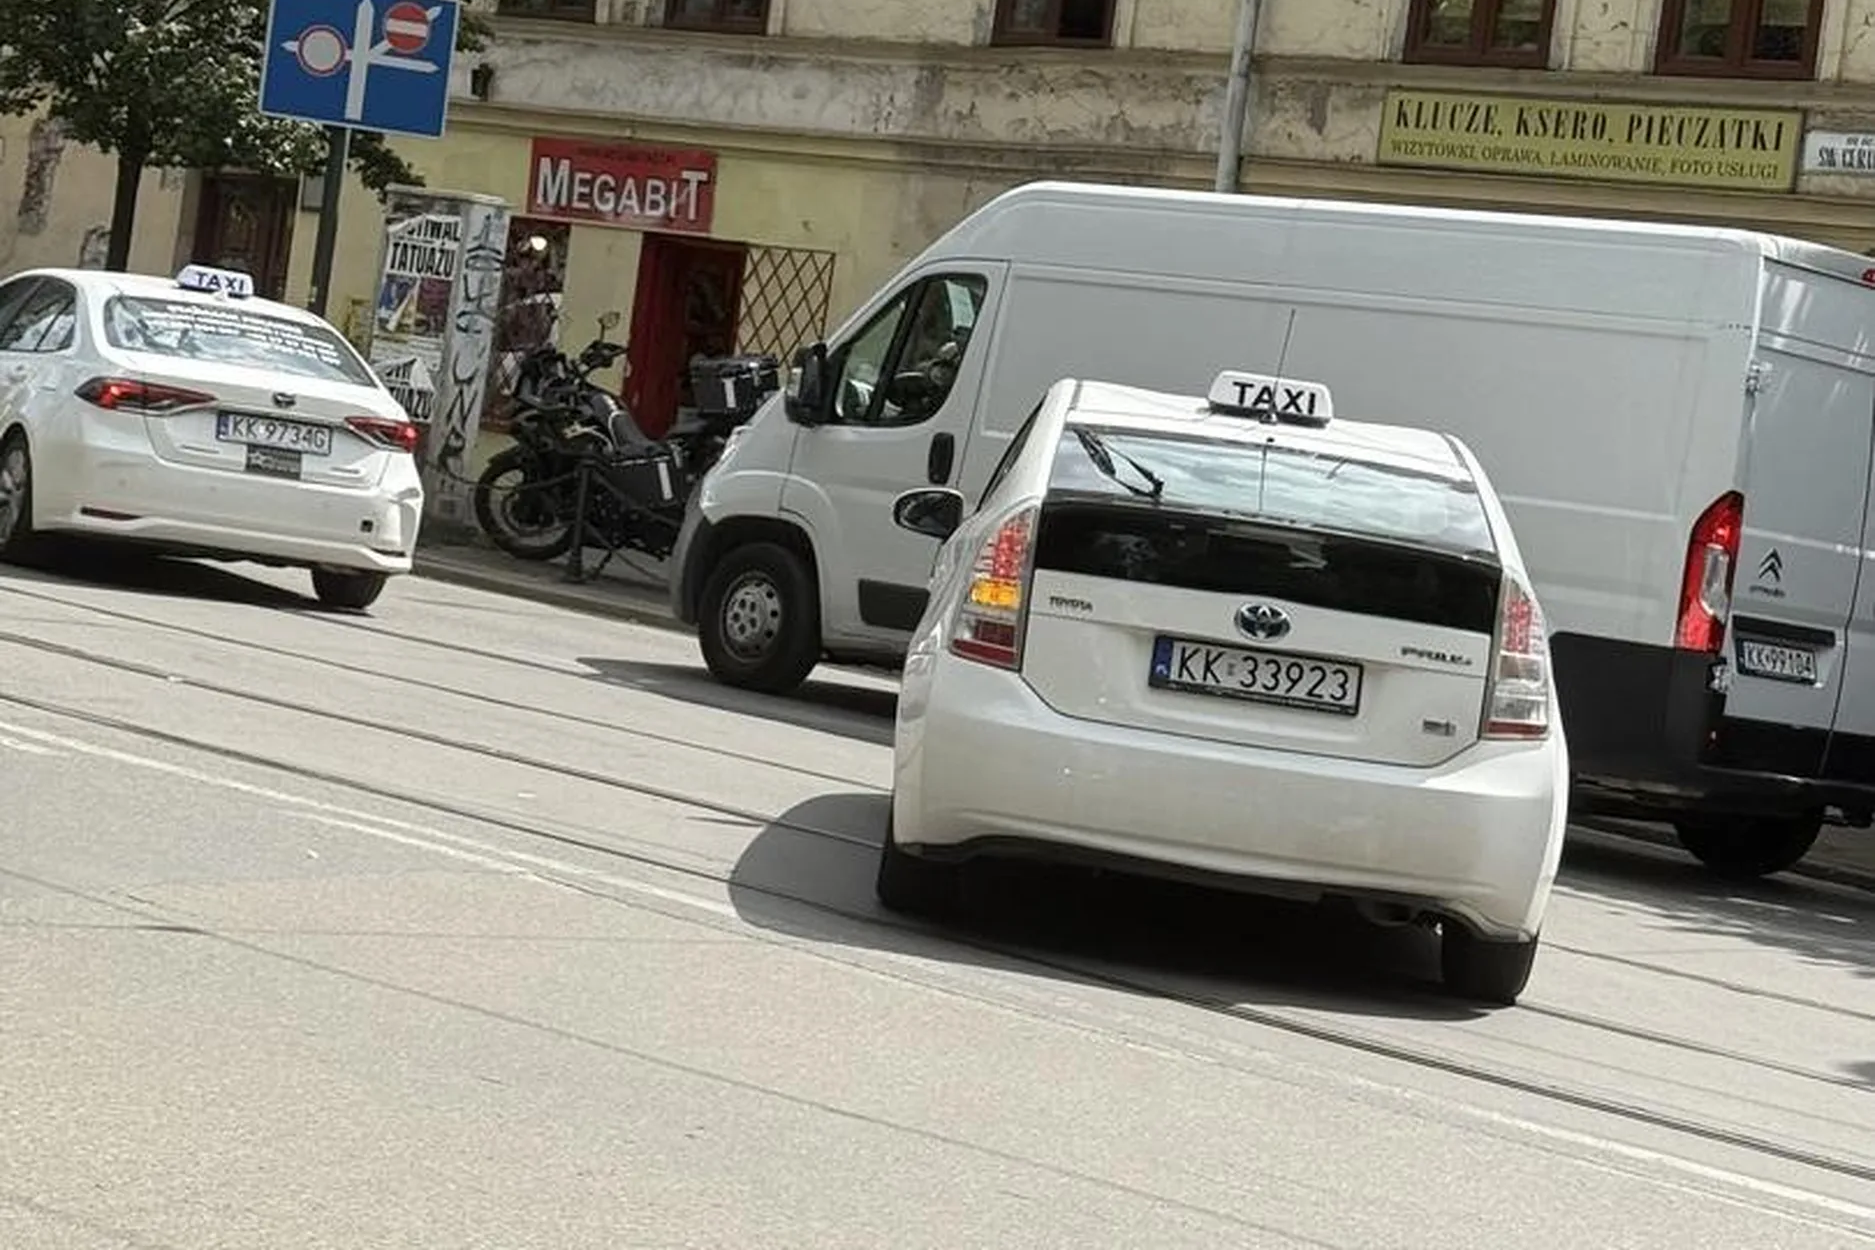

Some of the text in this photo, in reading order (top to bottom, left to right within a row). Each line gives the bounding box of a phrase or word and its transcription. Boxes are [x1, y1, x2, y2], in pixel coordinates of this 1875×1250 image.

[1626, 112, 1783, 154] PIECZĄTKI
[1670, 157, 1713, 176] FOTO
[536, 156, 708, 221] MEGABIT
[390, 241, 456, 278] TATUAŻU
[195, 272, 246, 292] TAXI
[1232, 381, 1316, 415] TAXI
[233, 415, 326, 449] KK 9734G
[1178, 646, 1227, 684] KK
[1240, 655, 1349, 701] 33923
